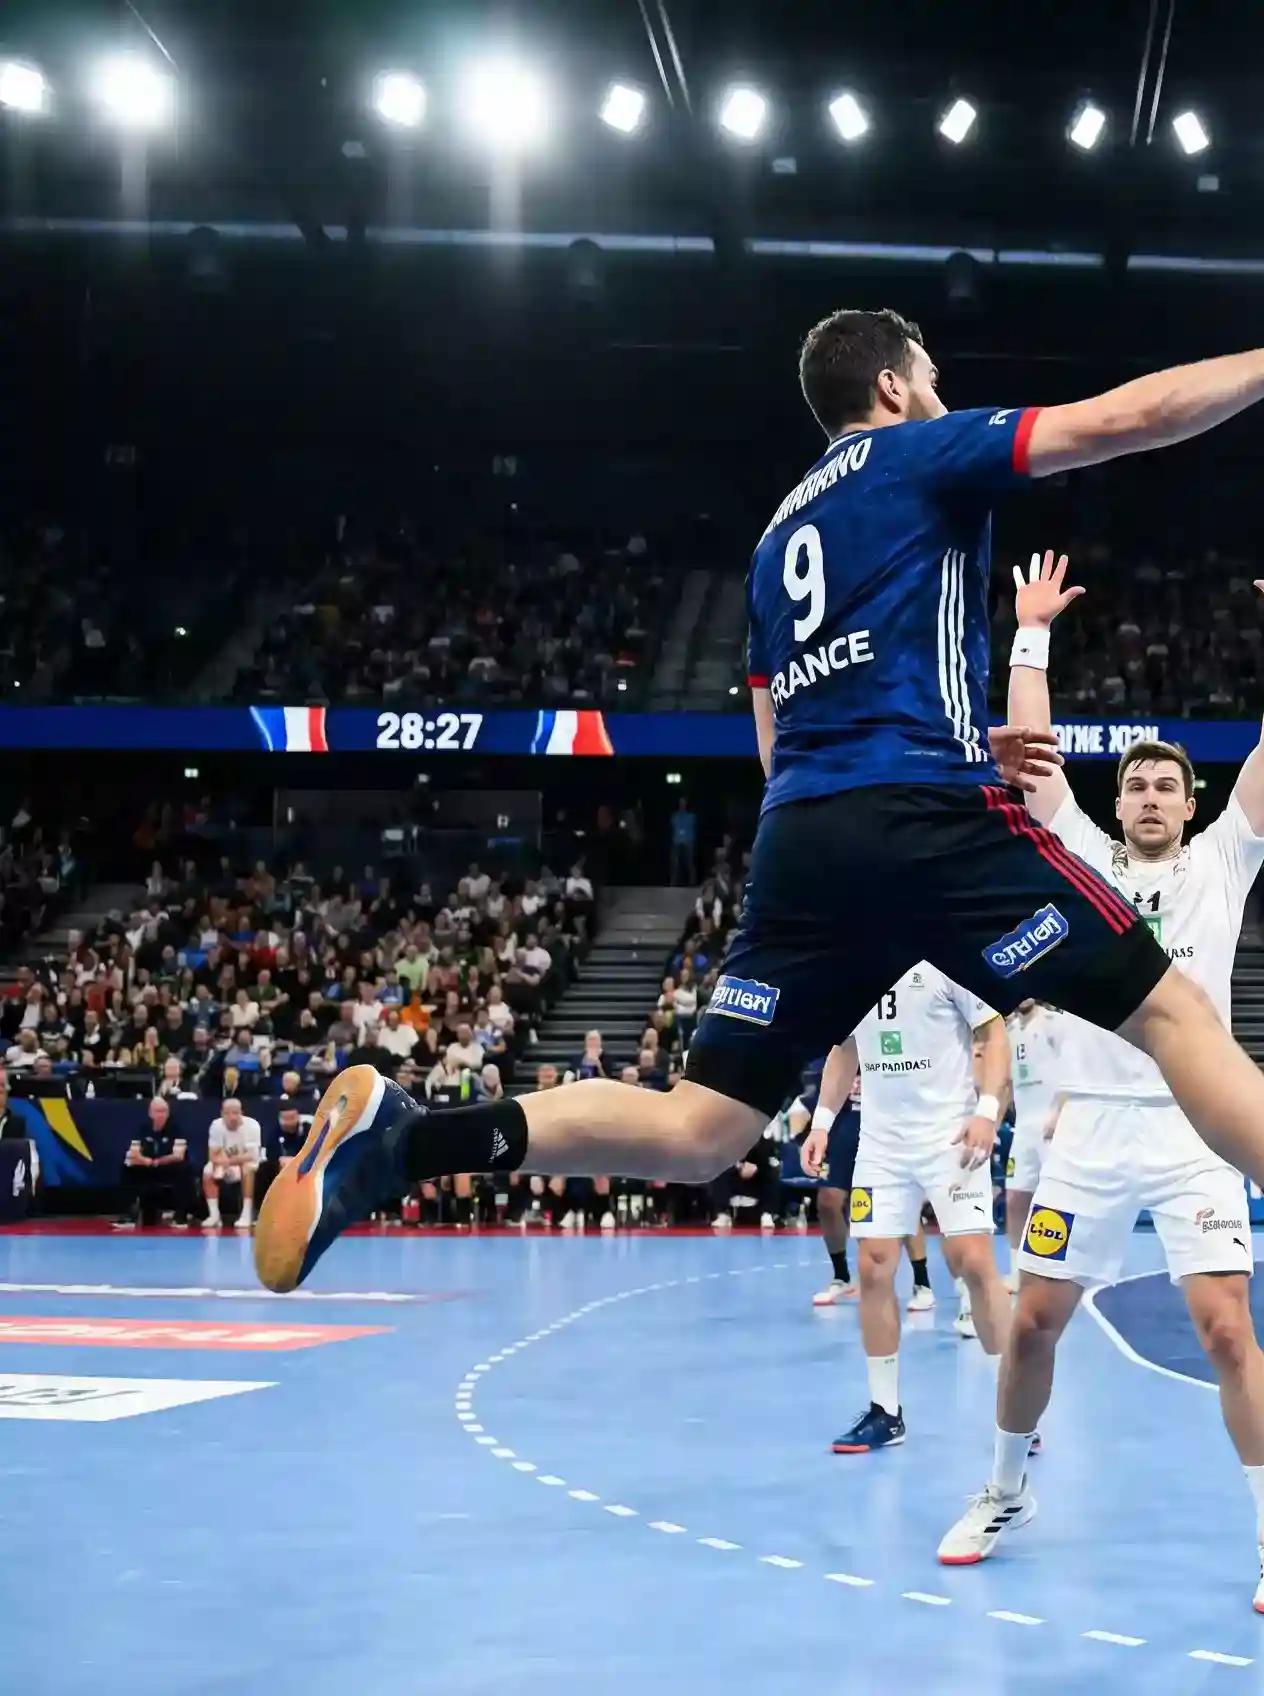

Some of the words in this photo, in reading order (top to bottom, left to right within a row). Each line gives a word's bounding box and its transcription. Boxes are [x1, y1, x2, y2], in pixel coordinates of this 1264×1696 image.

[782, 524, 826, 642] 9
[771, 630, 874, 710] FRANCE
[376, 712, 483, 750] 28:27
